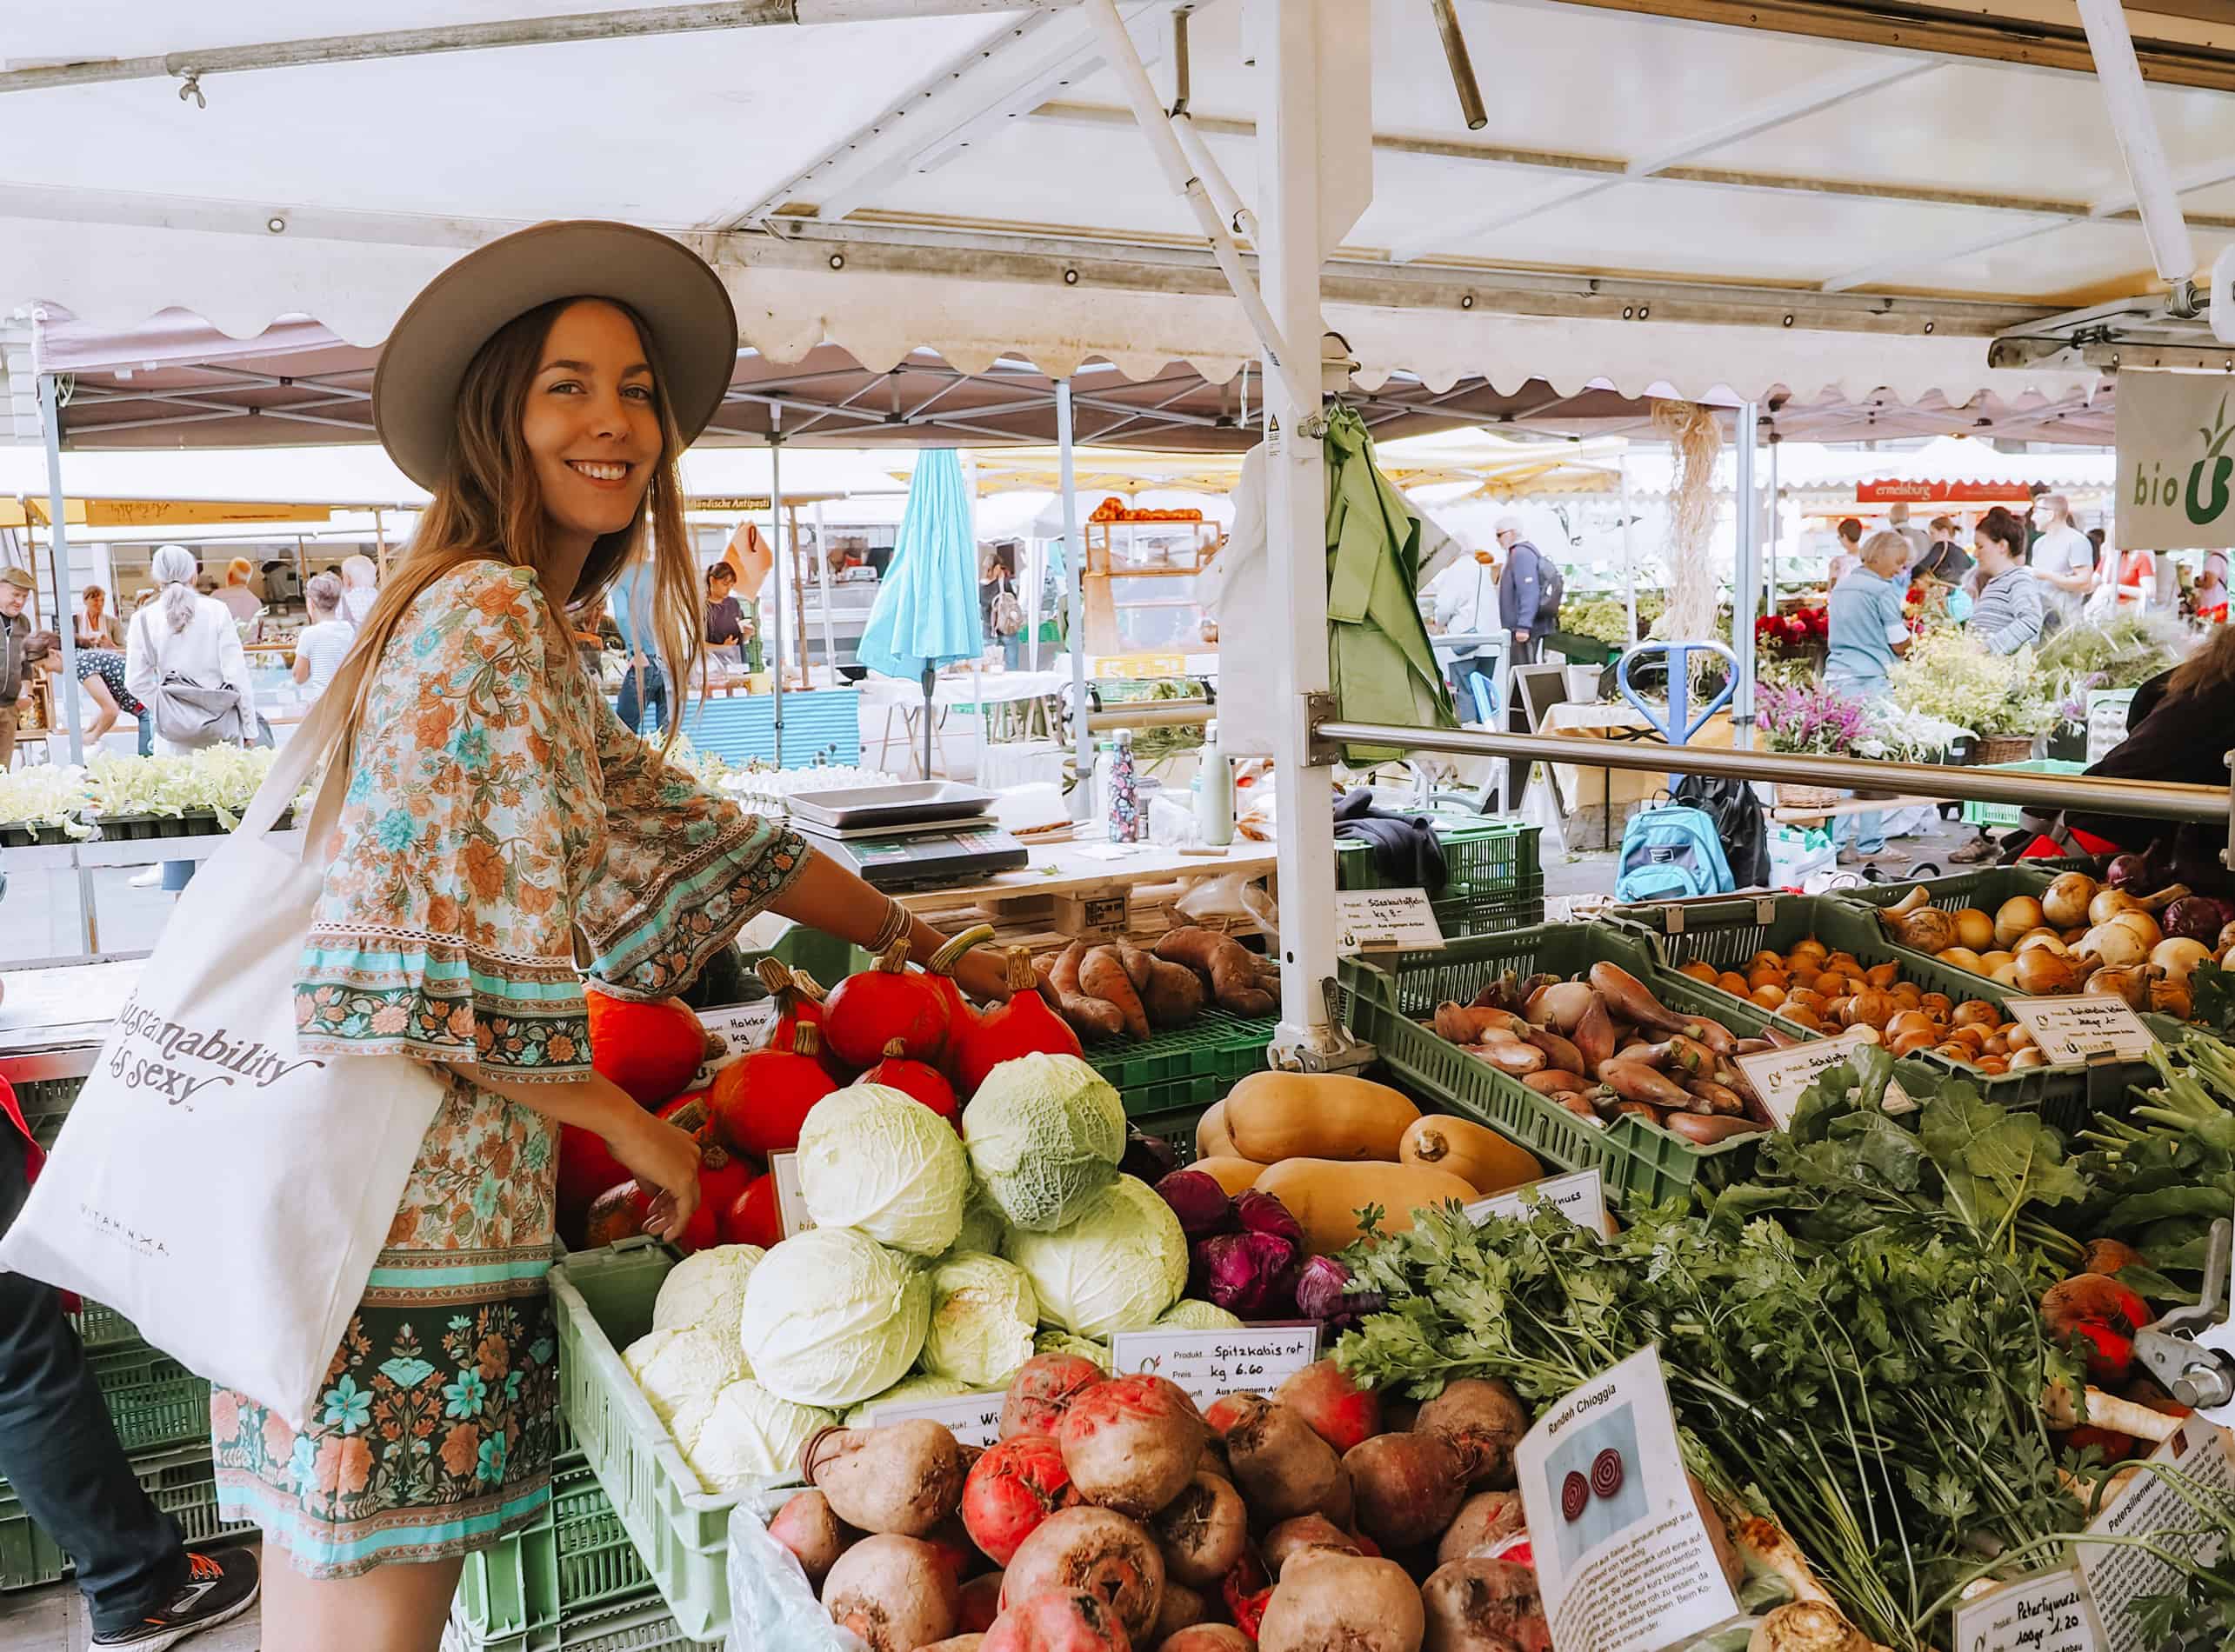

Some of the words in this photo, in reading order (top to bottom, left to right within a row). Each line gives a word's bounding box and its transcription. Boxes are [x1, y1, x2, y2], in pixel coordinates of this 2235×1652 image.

[110, 1039, 132, 1078] is
[126, 1058, 235, 1105] sexy
[1174, 1350, 1203, 1359] Produkt
[1215, 1343, 1282, 1360] Spitzkabis
[1286, 1342, 1304, 1355] rot
[1211, 1364, 1227, 1382] kg
[1236, 1363, 1264, 1376] 6.60
[1577, 1383, 1616, 1414] Chioggia
[2051, 1615, 2079, 1635] 1.20
